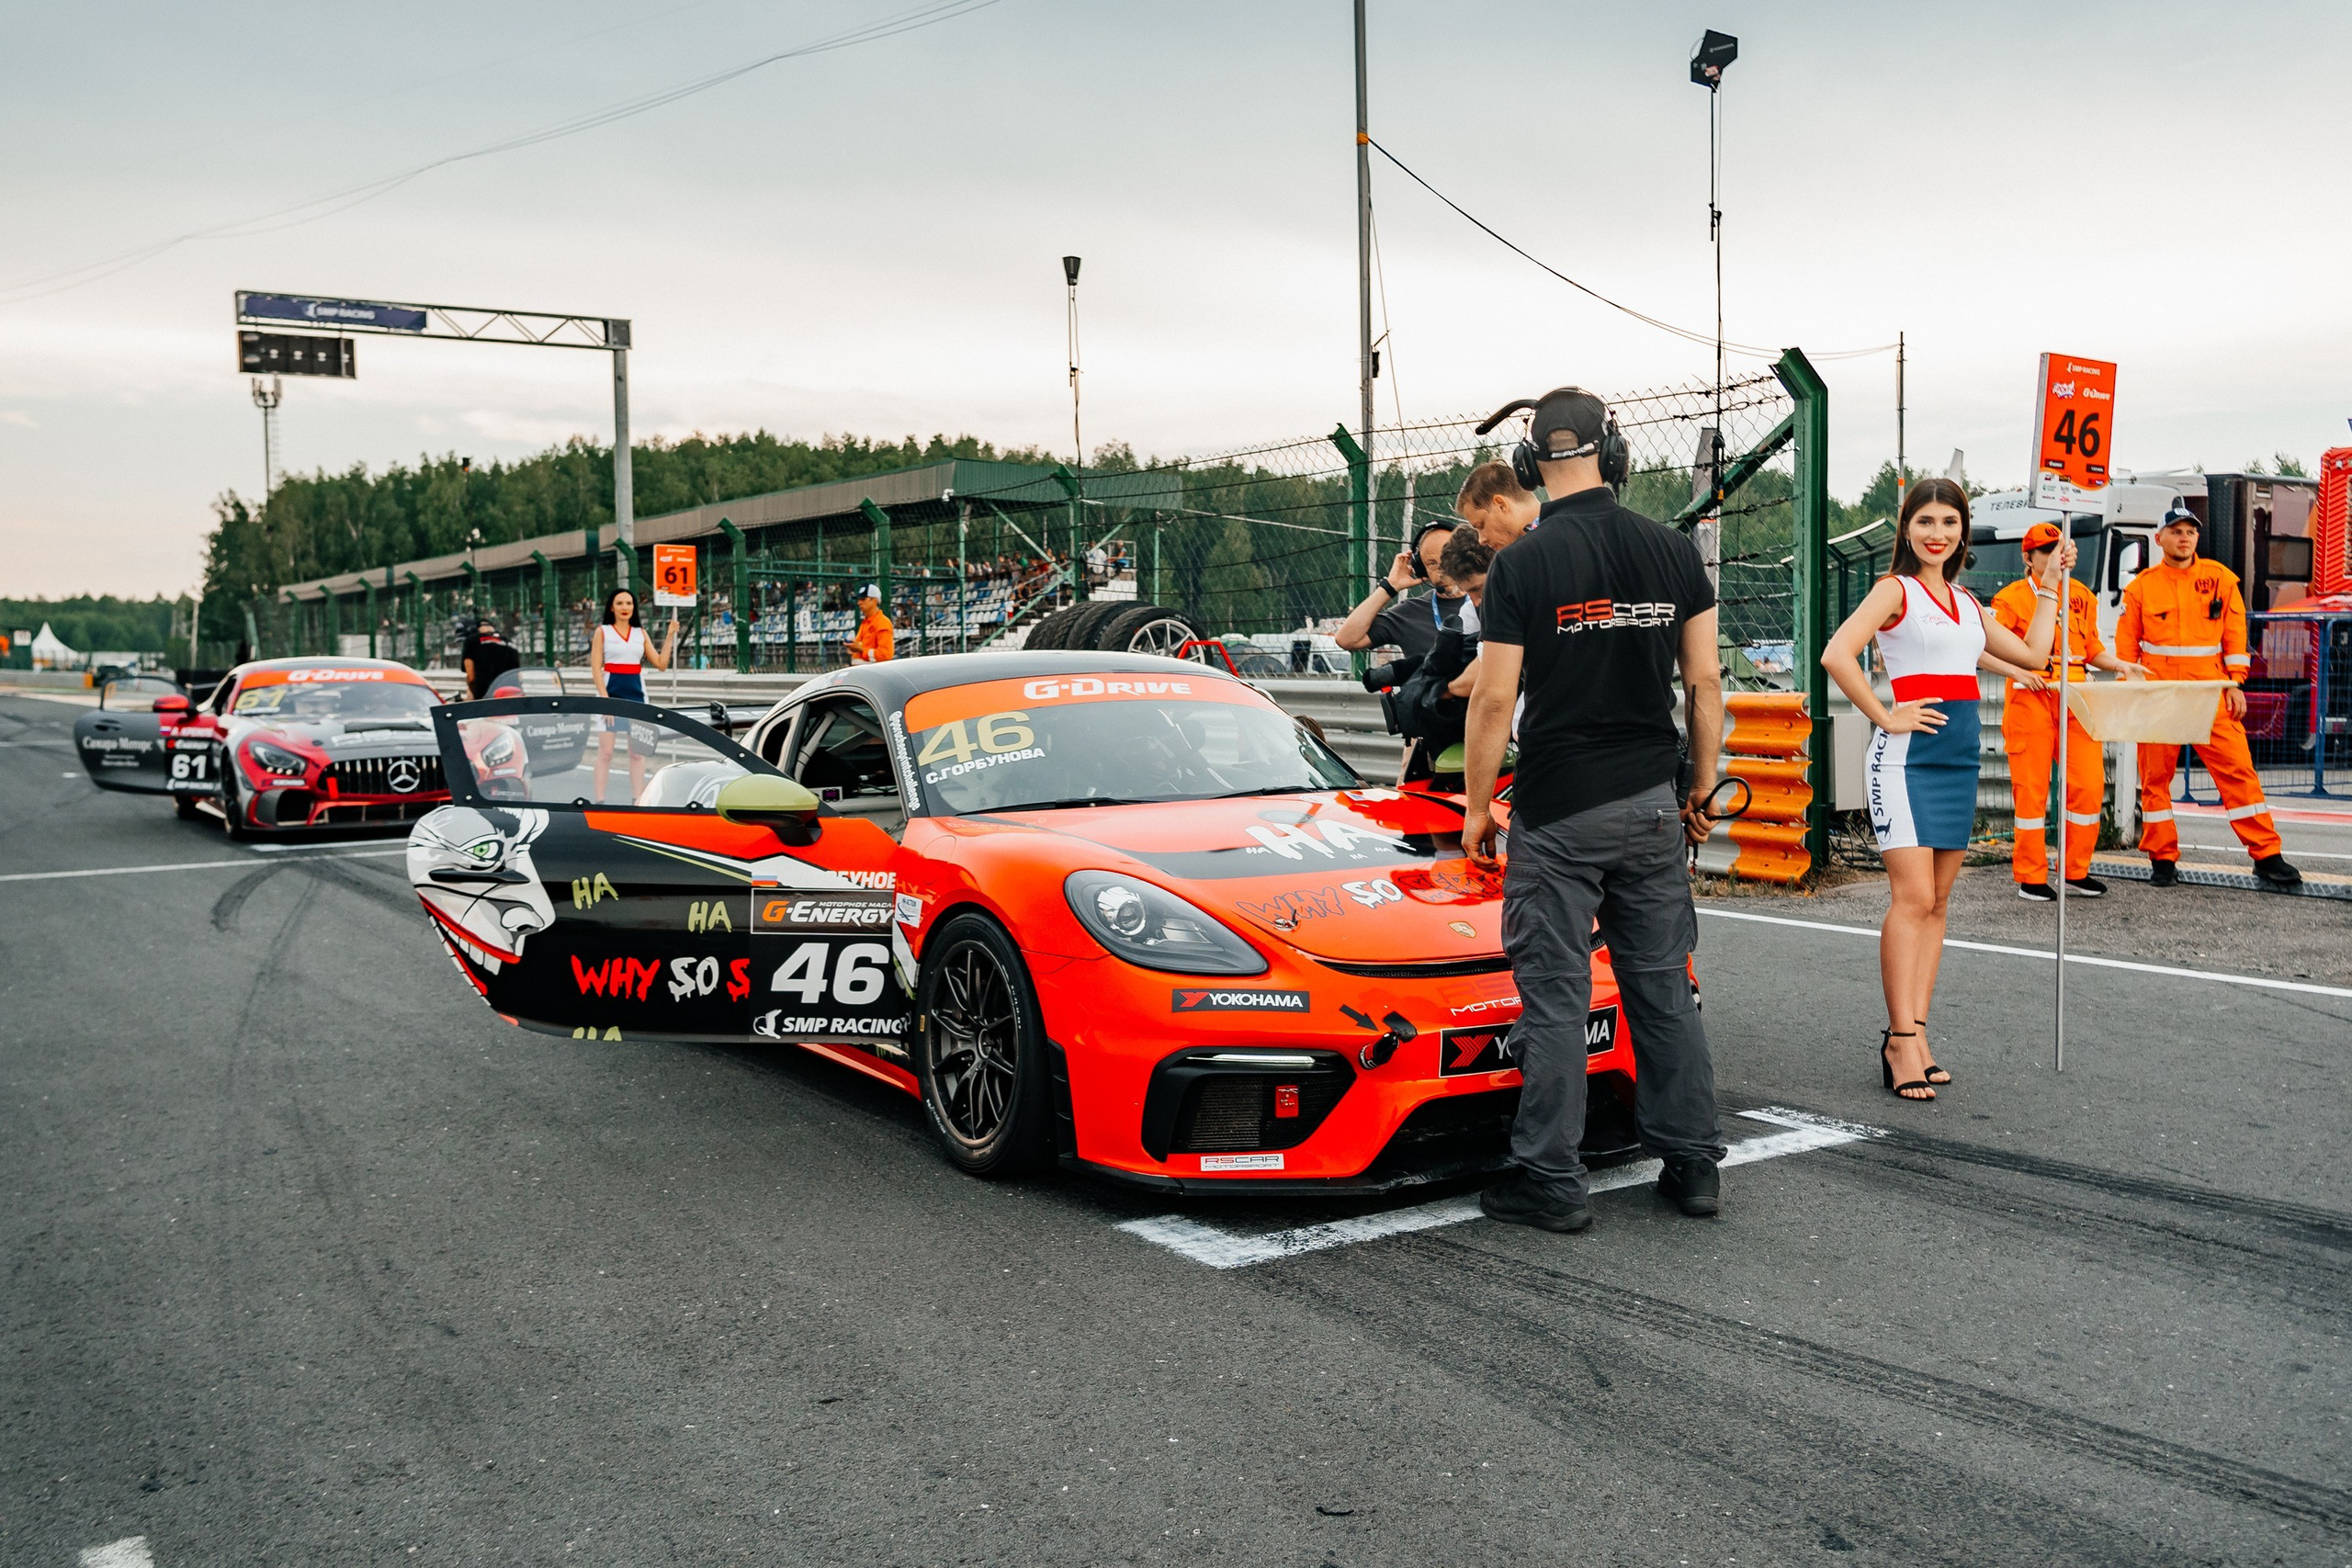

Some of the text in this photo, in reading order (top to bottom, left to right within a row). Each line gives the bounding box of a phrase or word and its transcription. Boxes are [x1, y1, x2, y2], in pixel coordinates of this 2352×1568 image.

[2053, 409, 2100, 457] 46
[664, 566, 687, 584] 61
[1556, 599, 1676, 625] RSCAR
[1556, 617, 1675, 635] MOTORSPORT
[234, 688, 288, 710] 61
[917, 711, 1035, 766] 46
[172, 754, 207, 779] 61
[925, 748, 1046, 784] С.ГОРБУНОВА
[1871, 777, 1883, 817] SMP
[1244, 819, 1416, 860] HA
[1246, 846, 1272, 854] HA
[571, 873, 618, 909] HA
[1341, 879, 1403, 909] SO
[688, 901, 731, 933] HA
[571, 954, 661, 1002] WHY
[668, 956, 719, 1002] SO
[771, 942, 889, 1005] 46
[1209, 992, 1304, 1008] YOKOHAMA
[782, 1017, 828, 1033] SMP
[1204, 1156, 1279, 1164] RSCAR
